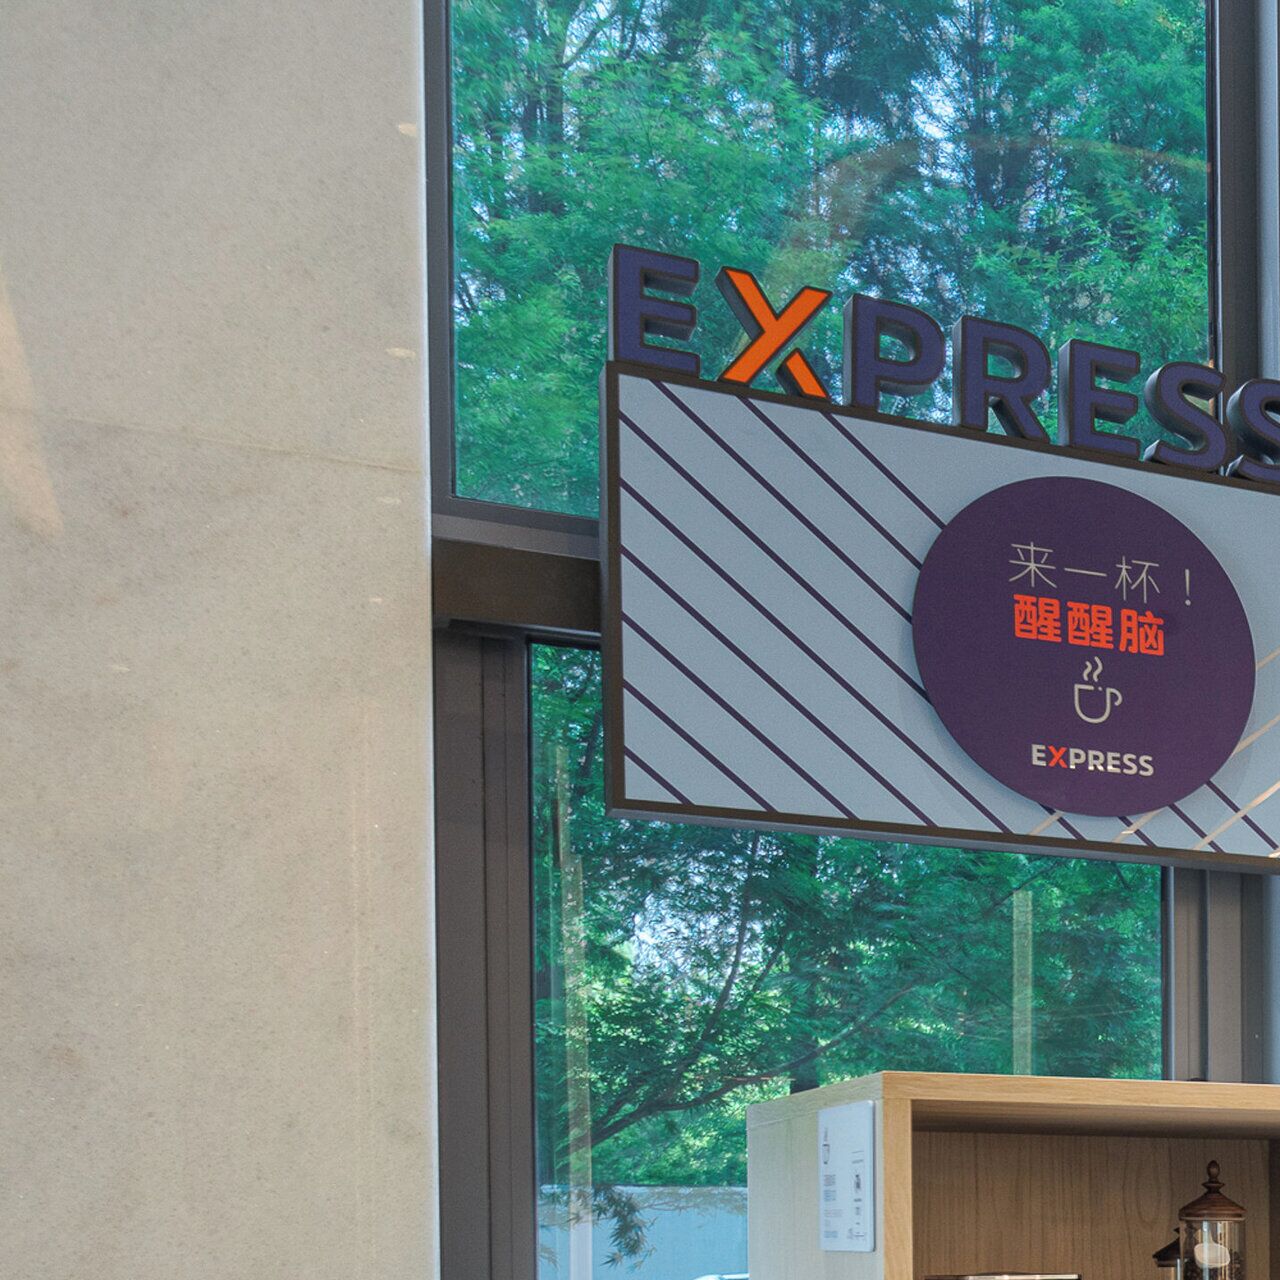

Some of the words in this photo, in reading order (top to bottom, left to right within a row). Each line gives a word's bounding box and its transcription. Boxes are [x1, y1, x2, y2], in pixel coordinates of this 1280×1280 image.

[1012, 592, 1166, 657] 醒醒脑
[1031, 744, 1154, 777] EXPRESS
